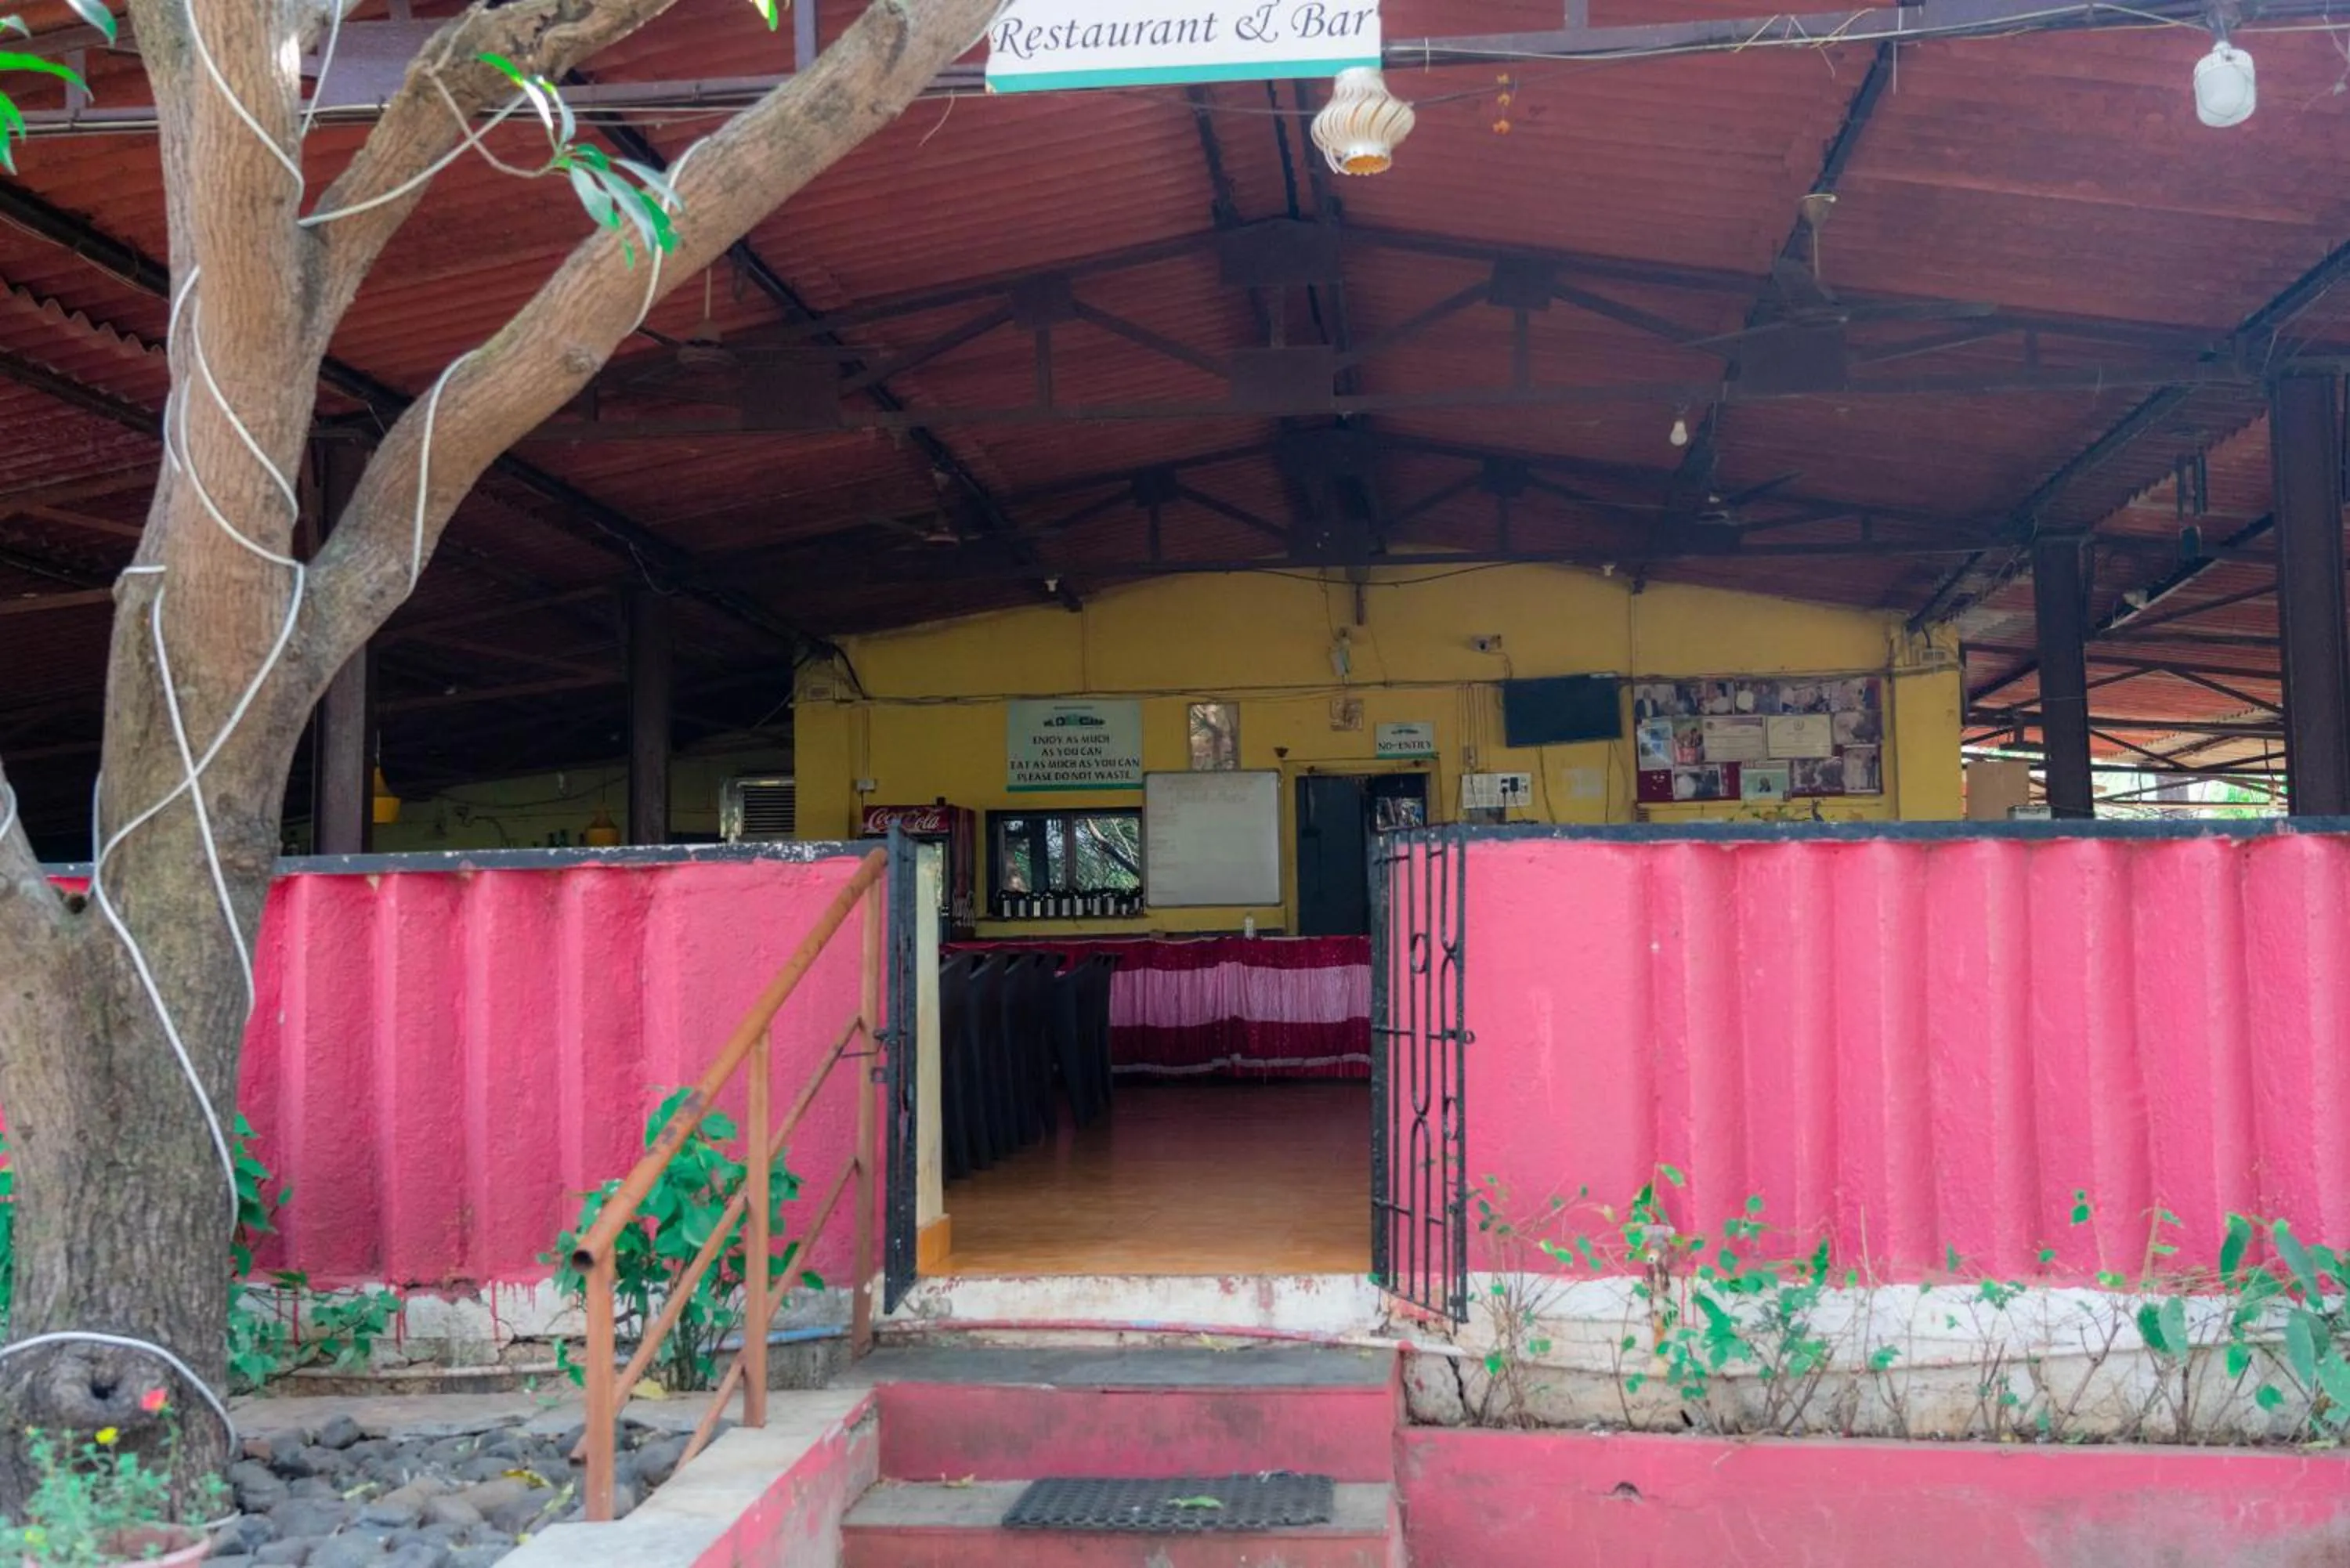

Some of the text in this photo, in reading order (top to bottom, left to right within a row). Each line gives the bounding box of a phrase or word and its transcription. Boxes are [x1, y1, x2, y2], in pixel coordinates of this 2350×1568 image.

[991, 0, 1374, 60] Restaurant & Bar
[1066, 735, 1079, 744] AS
[1081, 734, 1110, 743] MUCH
[1041, 746, 1102, 757] AS YOU CAN
[1032, 761, 1046, 769] AS
[1047, 760, 1077, 768] MUCH
[1079, 759, 1091, 768] AS
[1096, 758, 1116, 767] YOU
[1118, 757, 1140, 767] CAN
[1018, 772, 1051, 782] PLEASE
[1069, 771, 1091, 780] NOT
